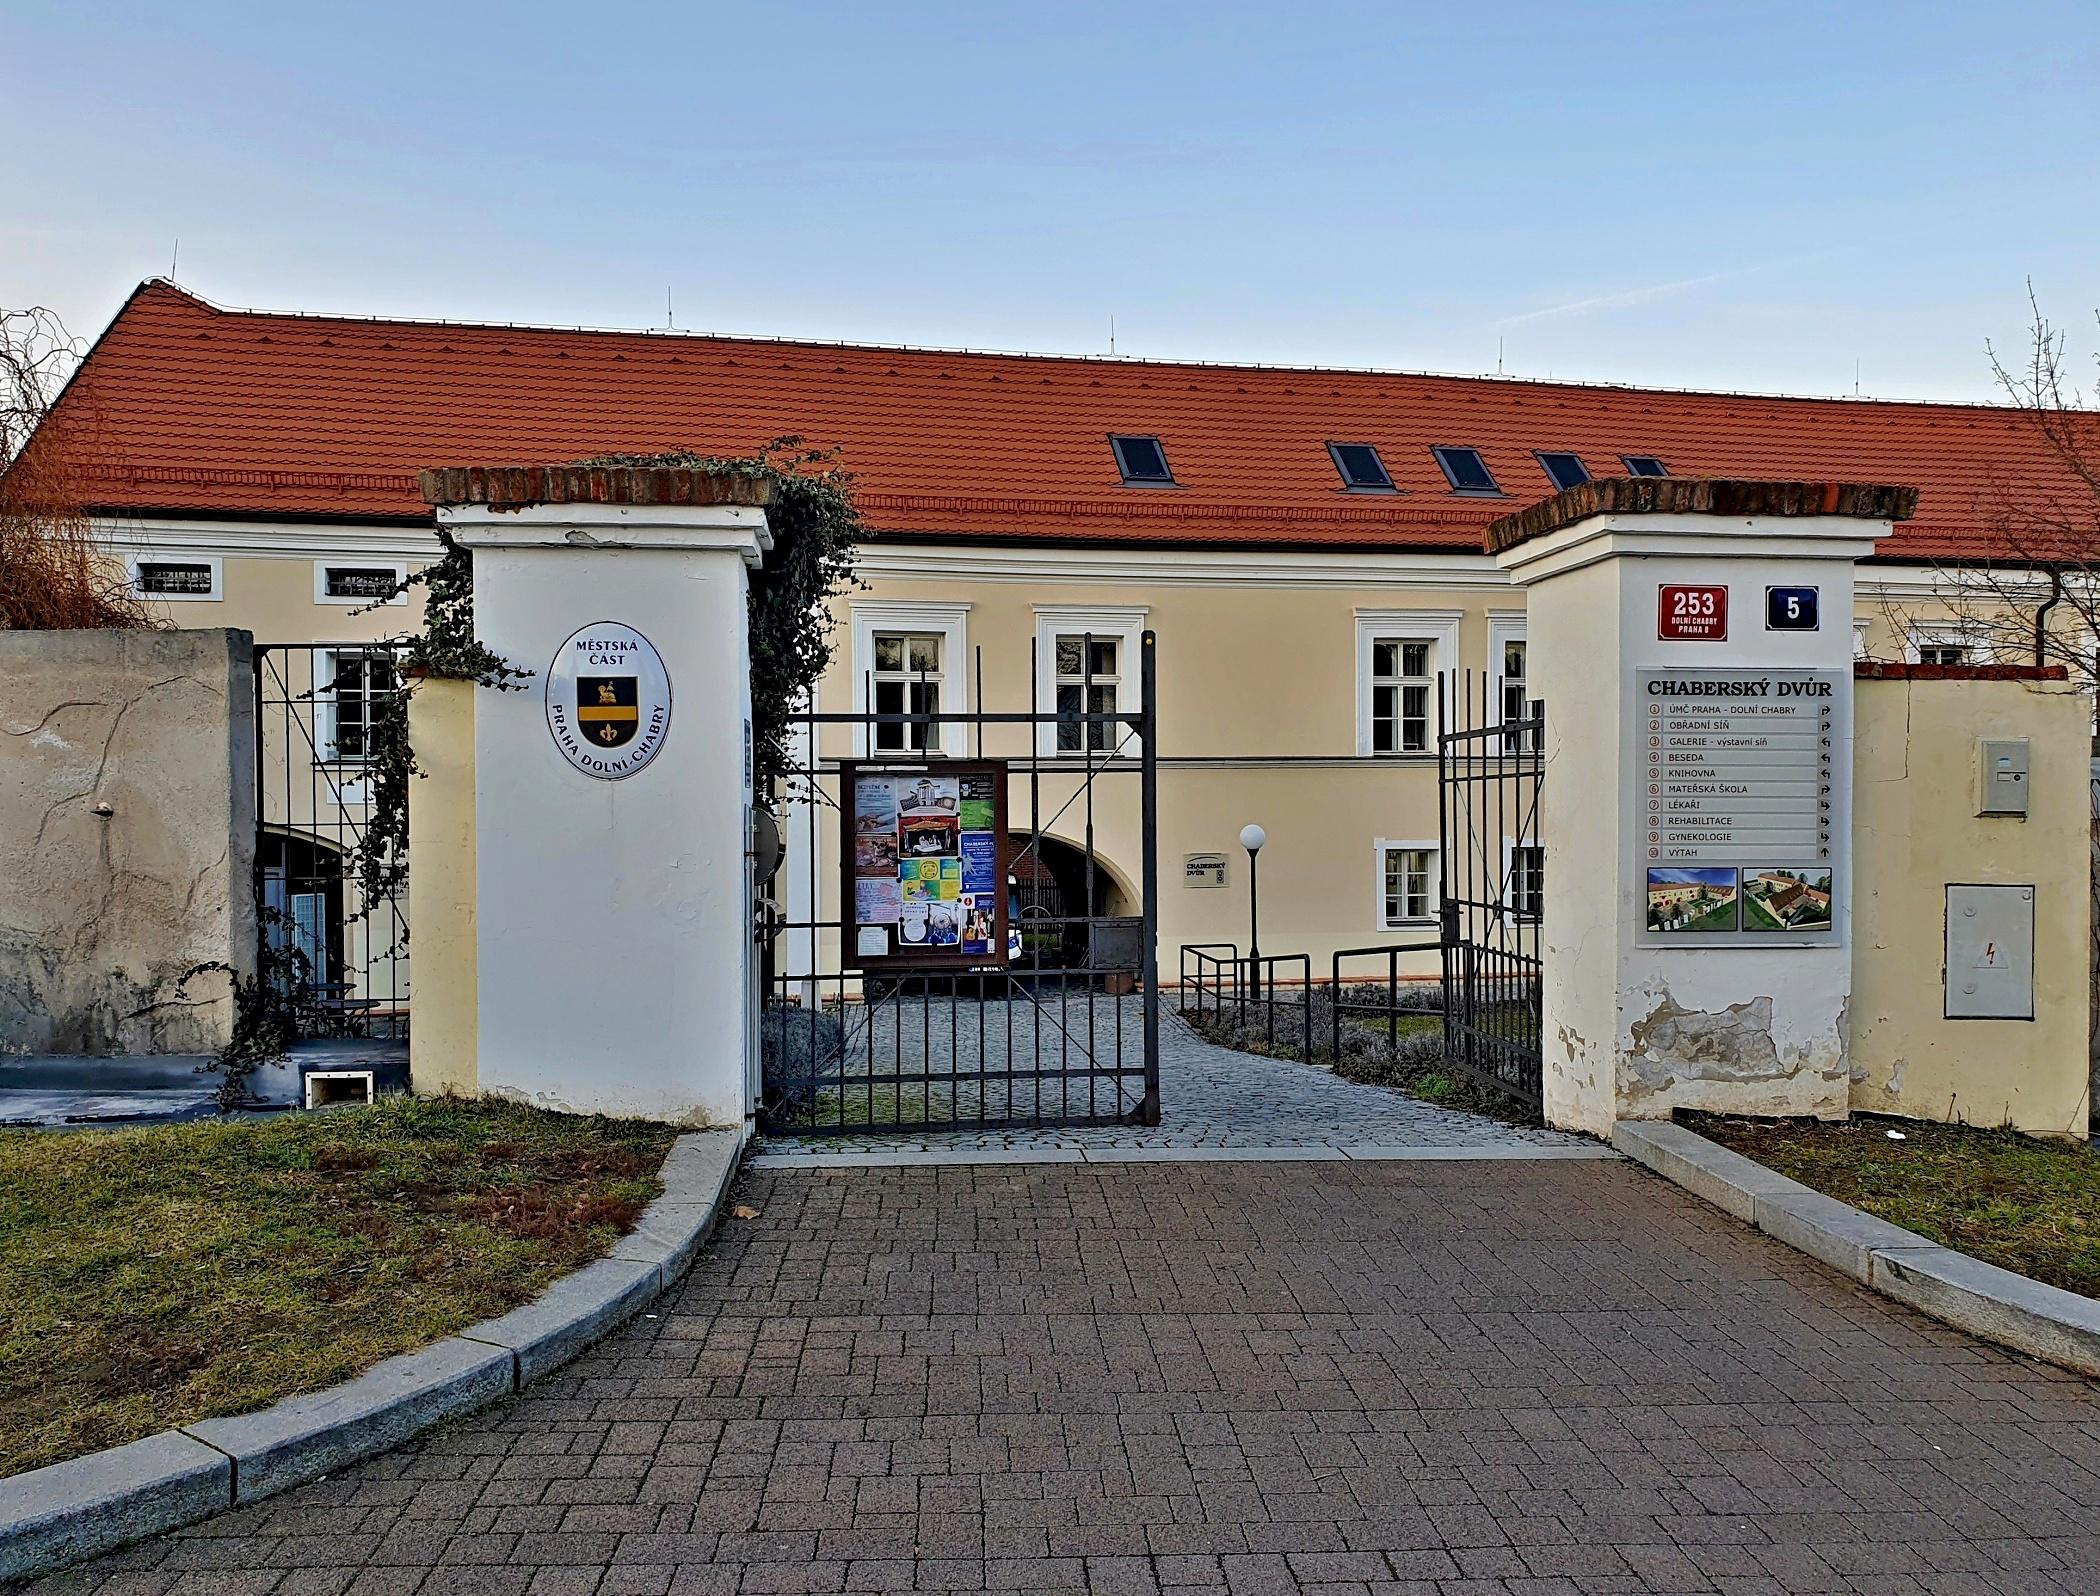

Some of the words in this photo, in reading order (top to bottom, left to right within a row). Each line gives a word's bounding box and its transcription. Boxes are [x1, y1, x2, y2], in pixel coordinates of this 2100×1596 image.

[1674, 592, 1714, 614] 253
[1788, 597, 1800, 619] 5
[1672, 616, 1691, 624] DOLNÍ
[576, 639, 638, 651] MĚSTSKÁ
[589, 652, 624, 664] ČÁST
[1648, 678, 1770, 696] CHABERSKÝ
[1777, 677, 1832, 696] DVŮR
[1670, 704, 1690, 713] ÚMČ
[1730, 704, 1758, 714] DOLNÍ
[1670, 720, 1710, 729] OBŘADNÍ
[552, 704, 579, 756] PRAHA
[1717, 737, 1752, 747] výstavní
[1755, 738, 1767, 746] síň
[1669, 784, 1716, 792] MATEŘSKÁ
[1718, 784, 1748, 793] ŠKOLA
[1669, 800, 1700, 808] LÉKAŘI
[1669, 847, 1697, 856] VÝTAH
